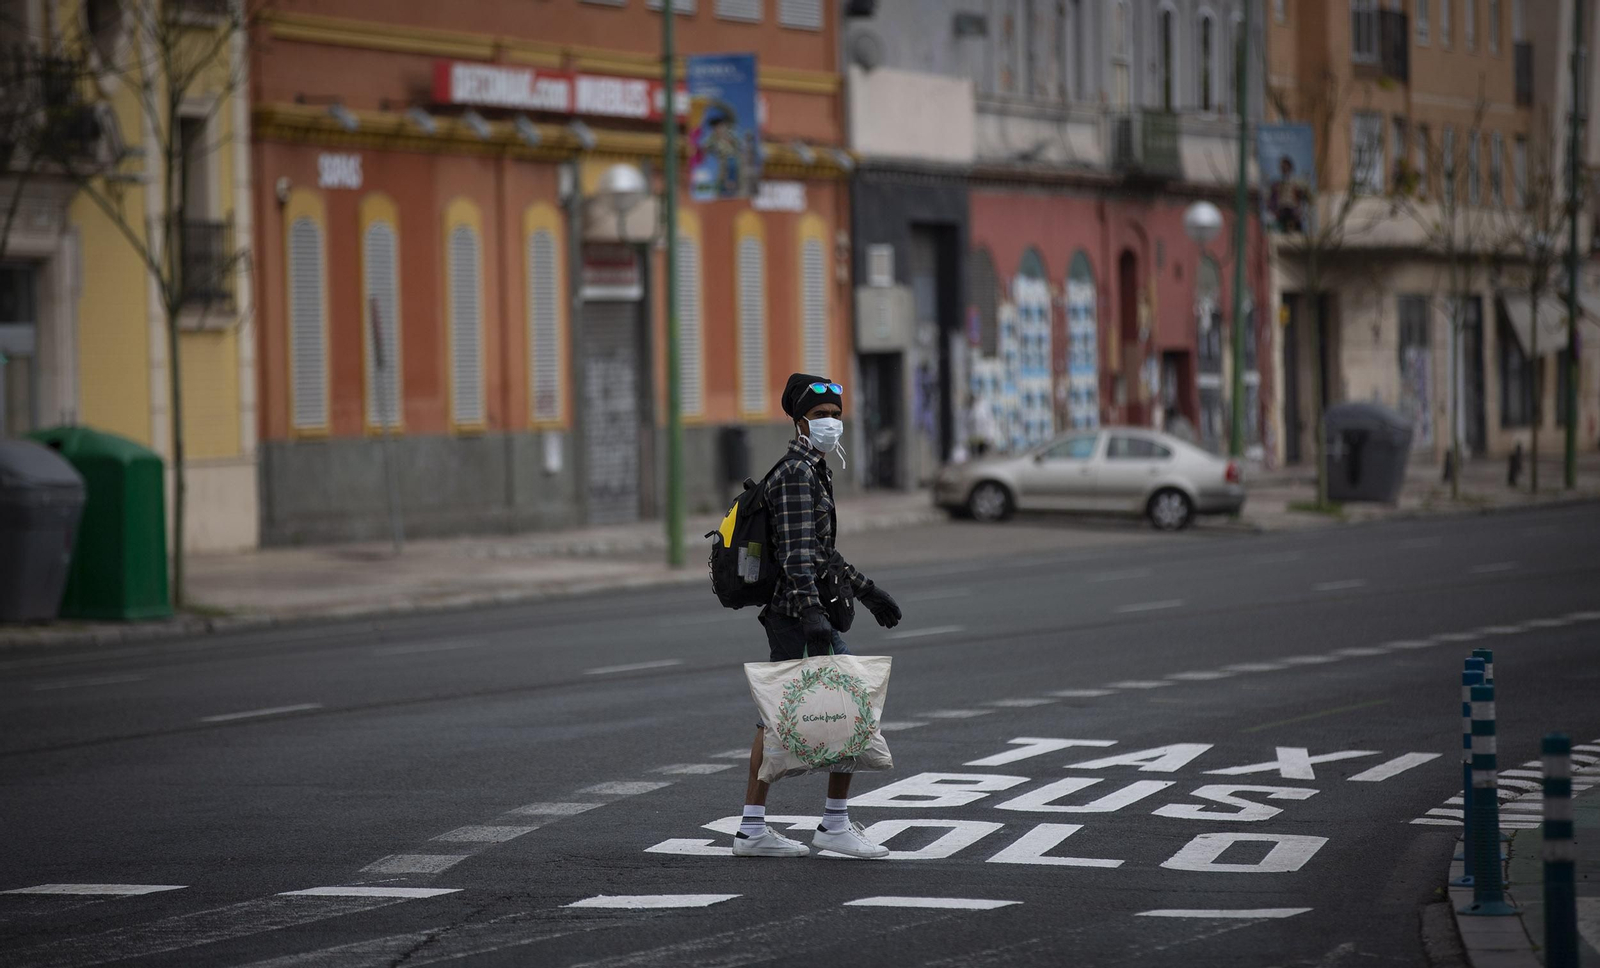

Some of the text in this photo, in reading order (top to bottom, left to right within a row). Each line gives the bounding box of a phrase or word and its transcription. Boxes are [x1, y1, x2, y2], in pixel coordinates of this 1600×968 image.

[809, 714, 824, 722] Corte
[961, 736, 1444, 782] TAXI
[847, 772, 1321, 822] BUS
[643, 814, 1330, 873] SOLO
